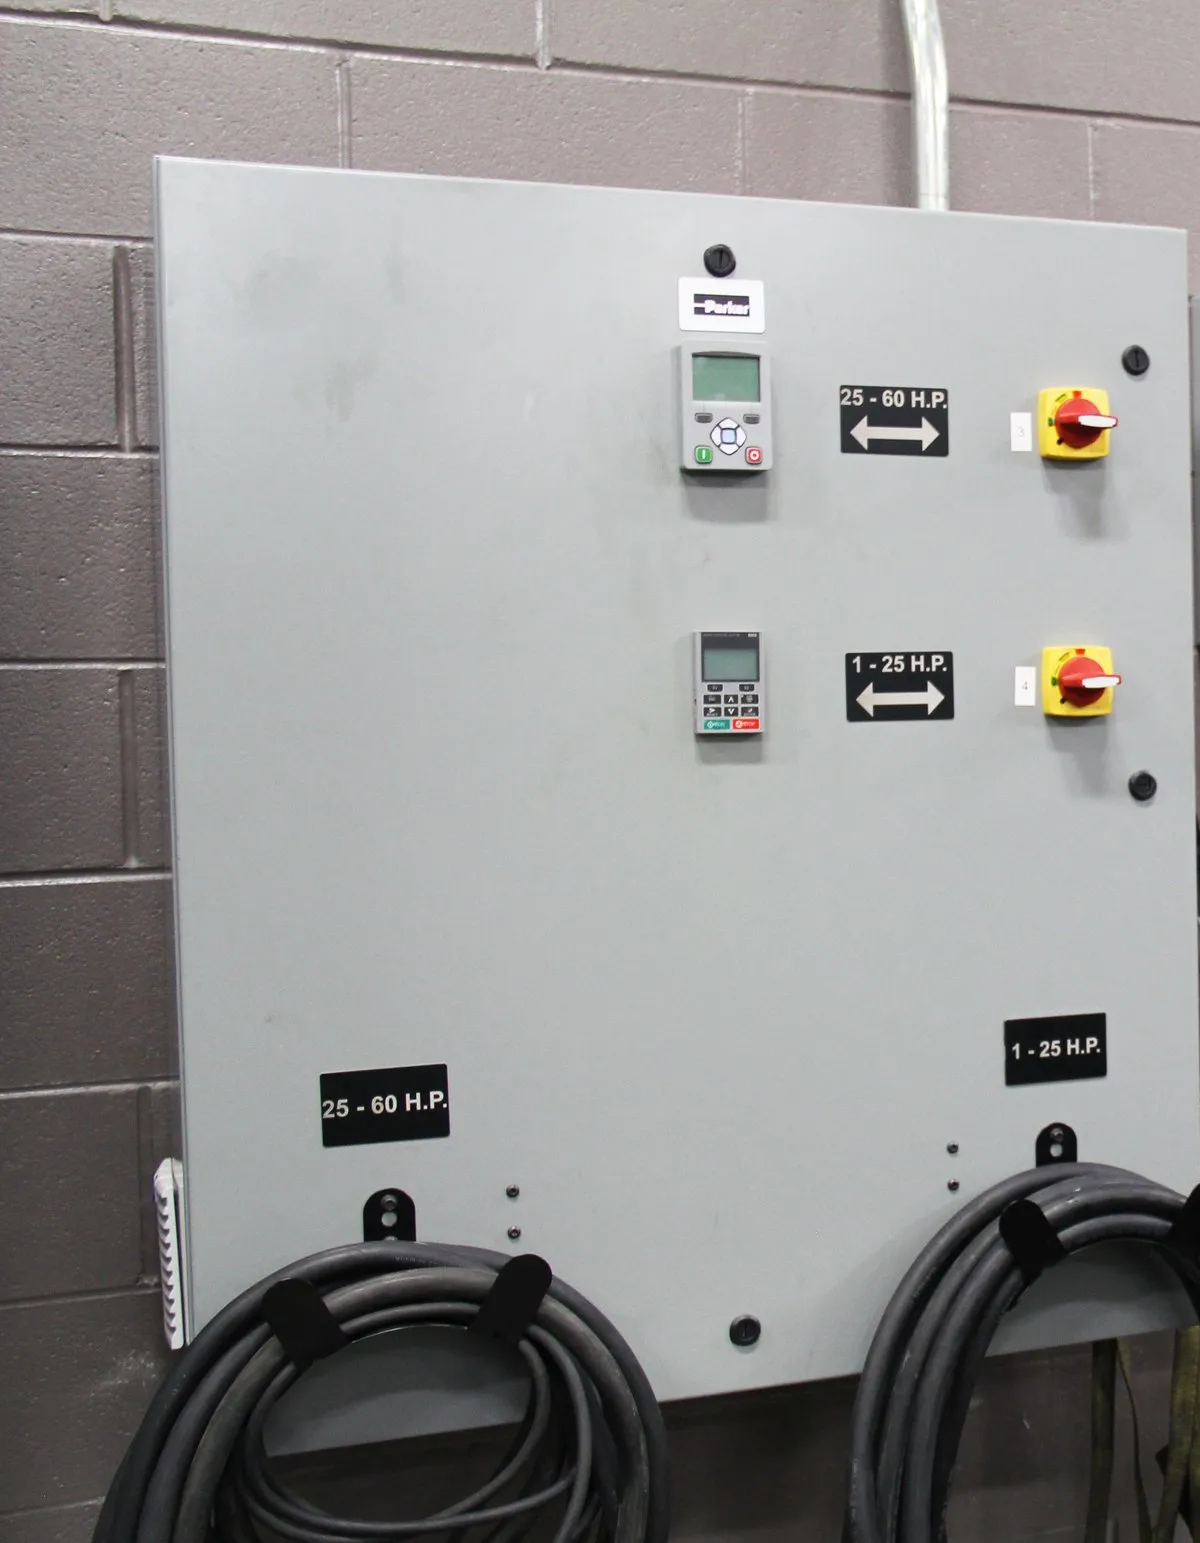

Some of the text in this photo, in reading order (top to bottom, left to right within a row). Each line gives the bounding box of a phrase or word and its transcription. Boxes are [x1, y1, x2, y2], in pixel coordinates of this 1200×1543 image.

[704, 299, 750, 315] Parker
[840, 388, 864, 406] 25
[882, 389, 905, 407] 60
[911, 390, 948, 409] H.P.
[852, 655, 861, 673] 1
[881, 654, 905, 673] 25
[910, 654, 947, 673] H.P.
[1012, 1042, 1020, 1060] 1
[1039, 1040, 1061, 1058] 25
[1066, 1036, 1101, 1056] H.P.
[322, 1098, 349, 1119] 25
[371, 1094, 398, 1114] 60
[405, 1090, 448, 1112] H.P.
